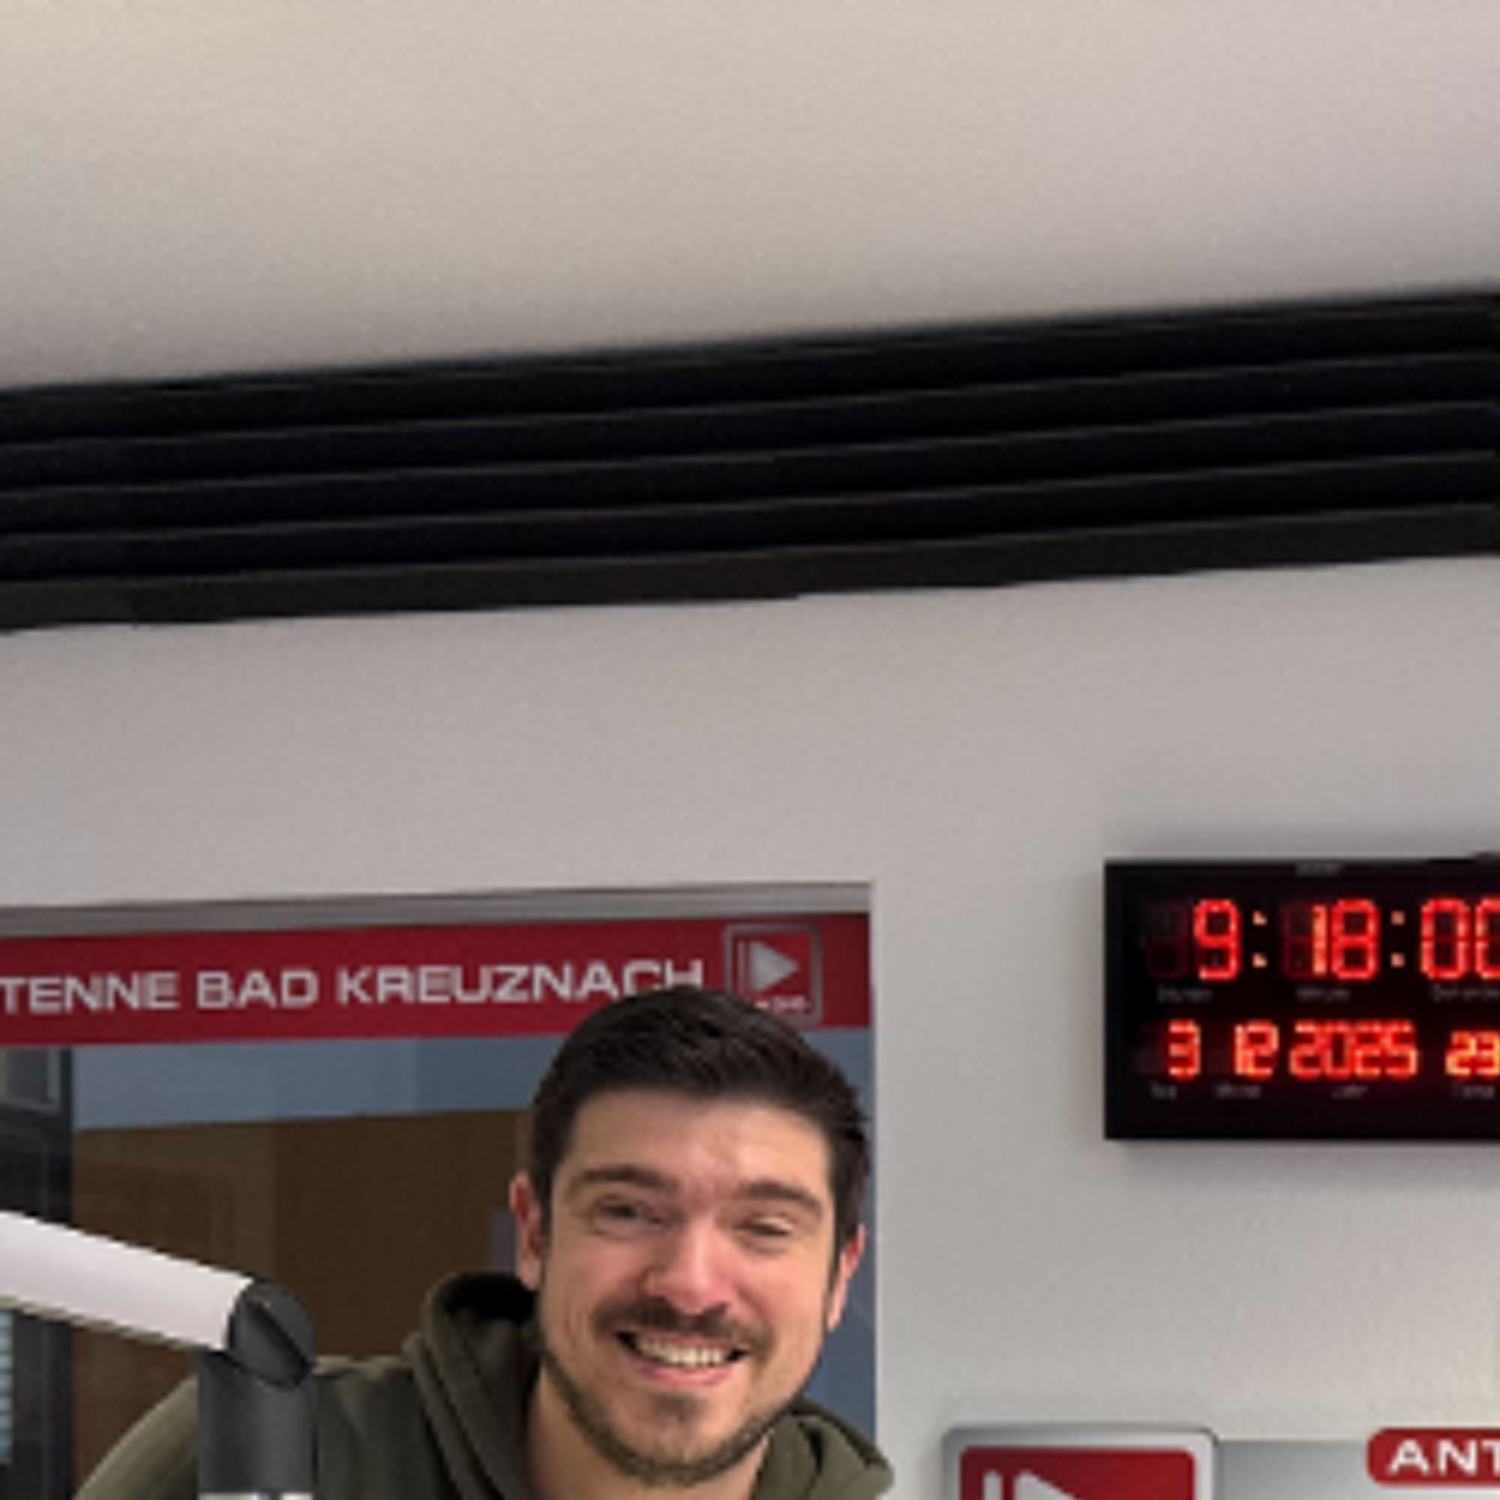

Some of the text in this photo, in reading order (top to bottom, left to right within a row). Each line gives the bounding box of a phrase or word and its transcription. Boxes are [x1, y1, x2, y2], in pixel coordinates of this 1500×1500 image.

[196, 969, 320, 1009] BAD
[337, 958, 705, 1006] KREUZNACH
[1166, 1018, 1201, 1080] 3
[1288, 1018, 1419, 1080] 2025
